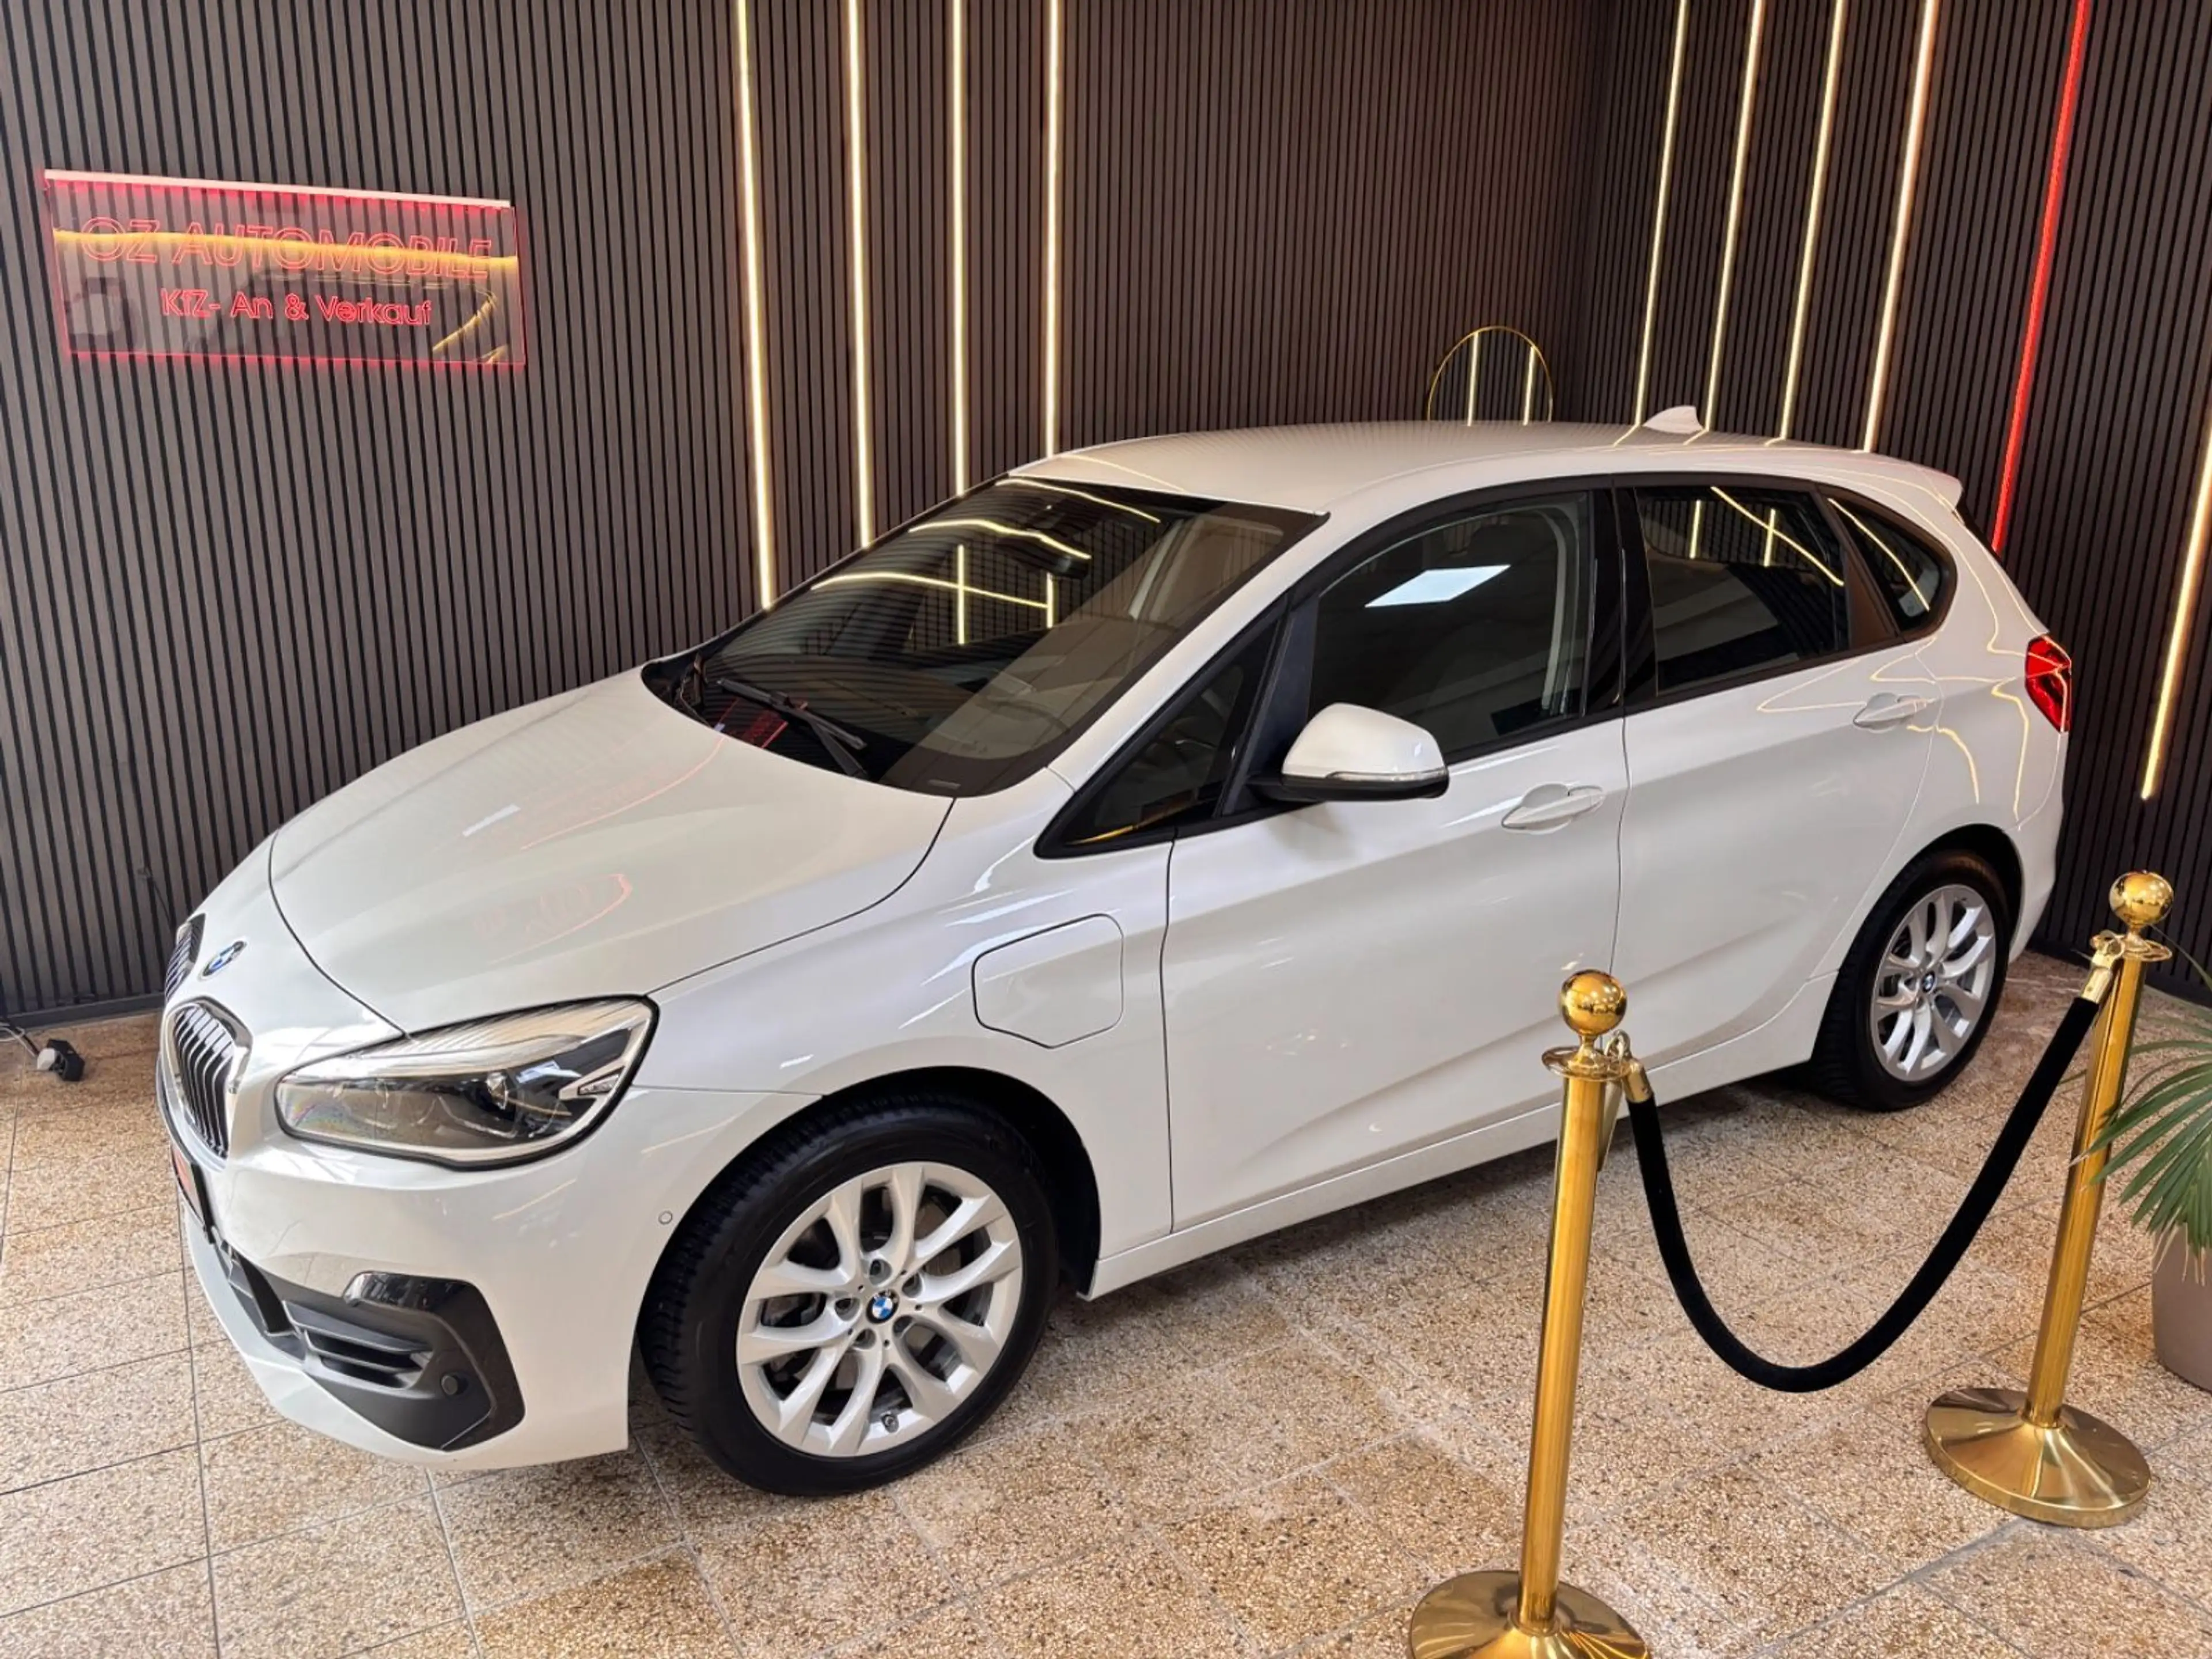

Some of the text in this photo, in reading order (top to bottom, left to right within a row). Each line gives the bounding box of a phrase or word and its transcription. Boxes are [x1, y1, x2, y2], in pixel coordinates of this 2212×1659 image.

[81, 216, 492, 279] OZ AUTOMOBILE
[231, 291, 273, 319] An
[284, 293, 309, 321] &
[315, 295, 433, 327] Verkauf
